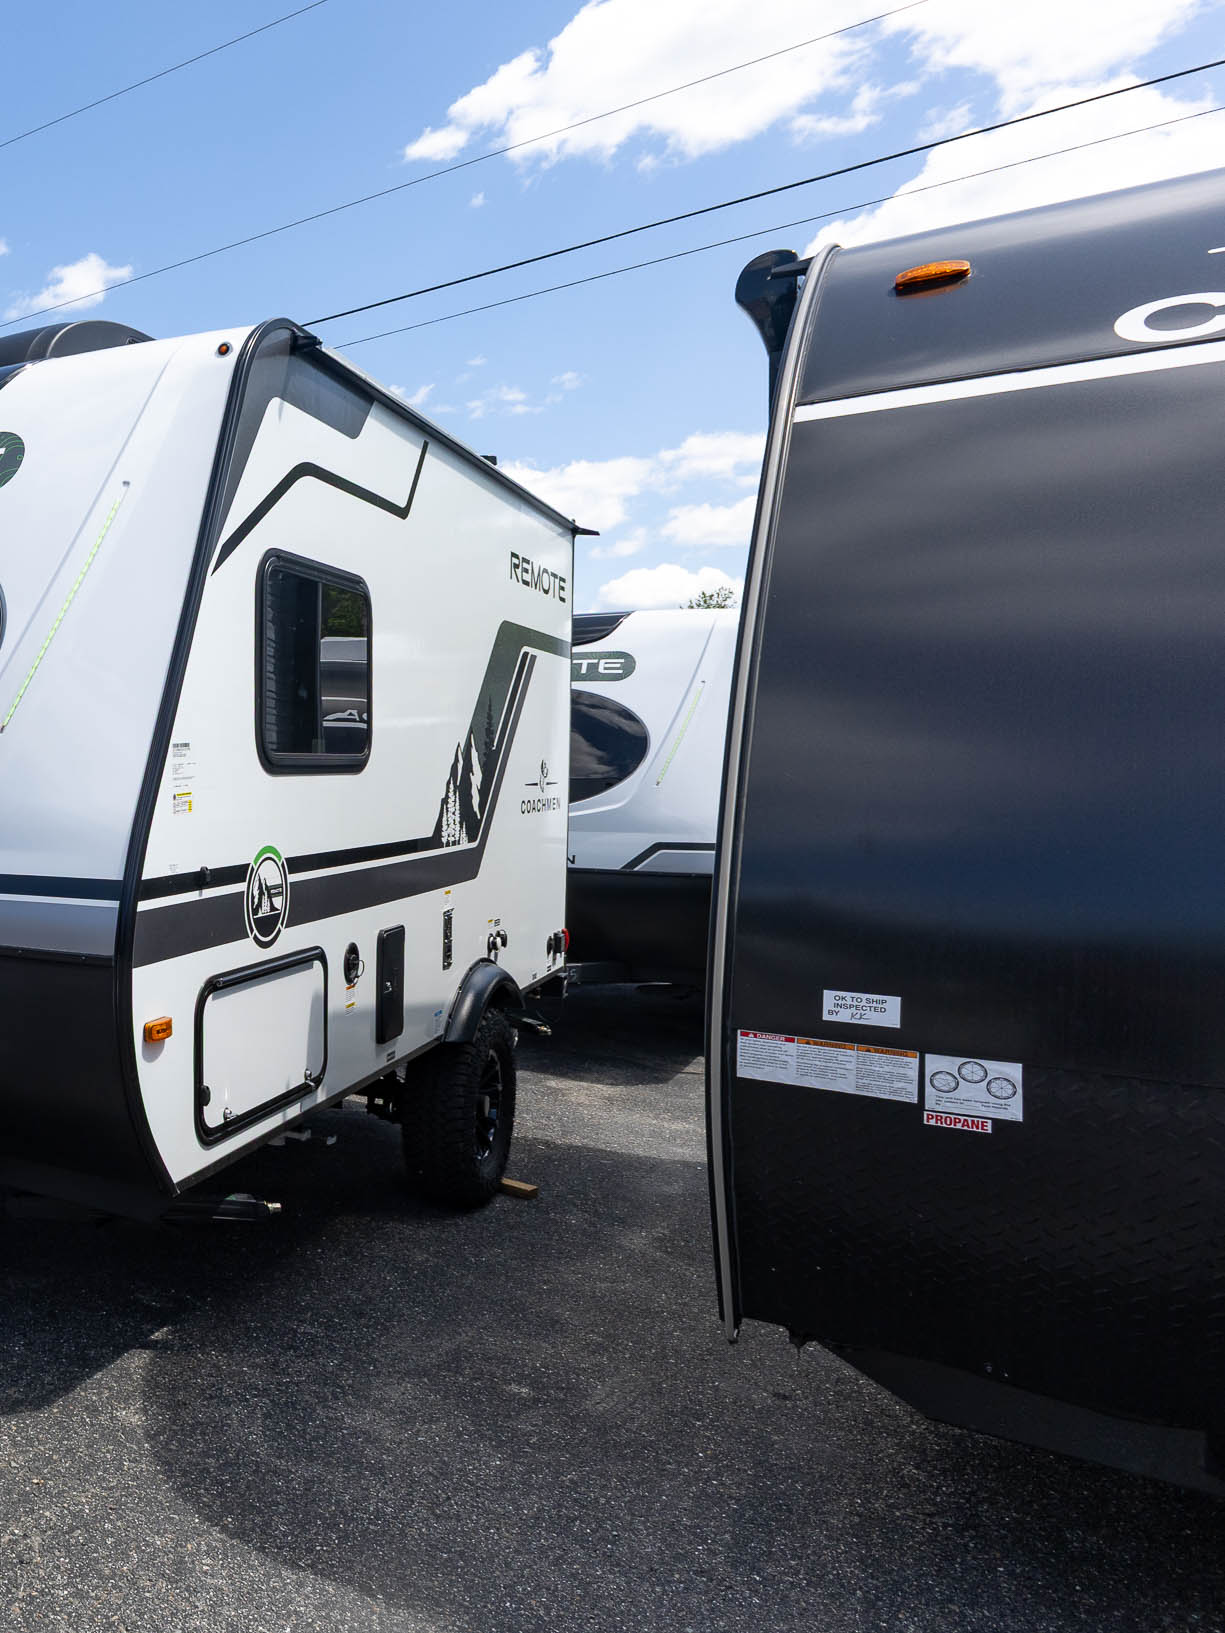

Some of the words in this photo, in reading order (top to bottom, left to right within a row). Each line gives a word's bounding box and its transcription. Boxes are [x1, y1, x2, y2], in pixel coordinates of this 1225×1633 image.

[510, 551, 566, 603] REMOTE
[520, 797, 561, 815] COACHMEN
[833, 994, 848, 1002] OK
[850, 996, 863, 1004] TO
[865, 997, 888, 1006] SHIP
[827, 1009, 840, 1017] BY
[833, 1002, 887, 1014] INSPECTED
[756, 1033, 785, 1042] DANGER
[925, 1112, 989, 1132] PROPANE
